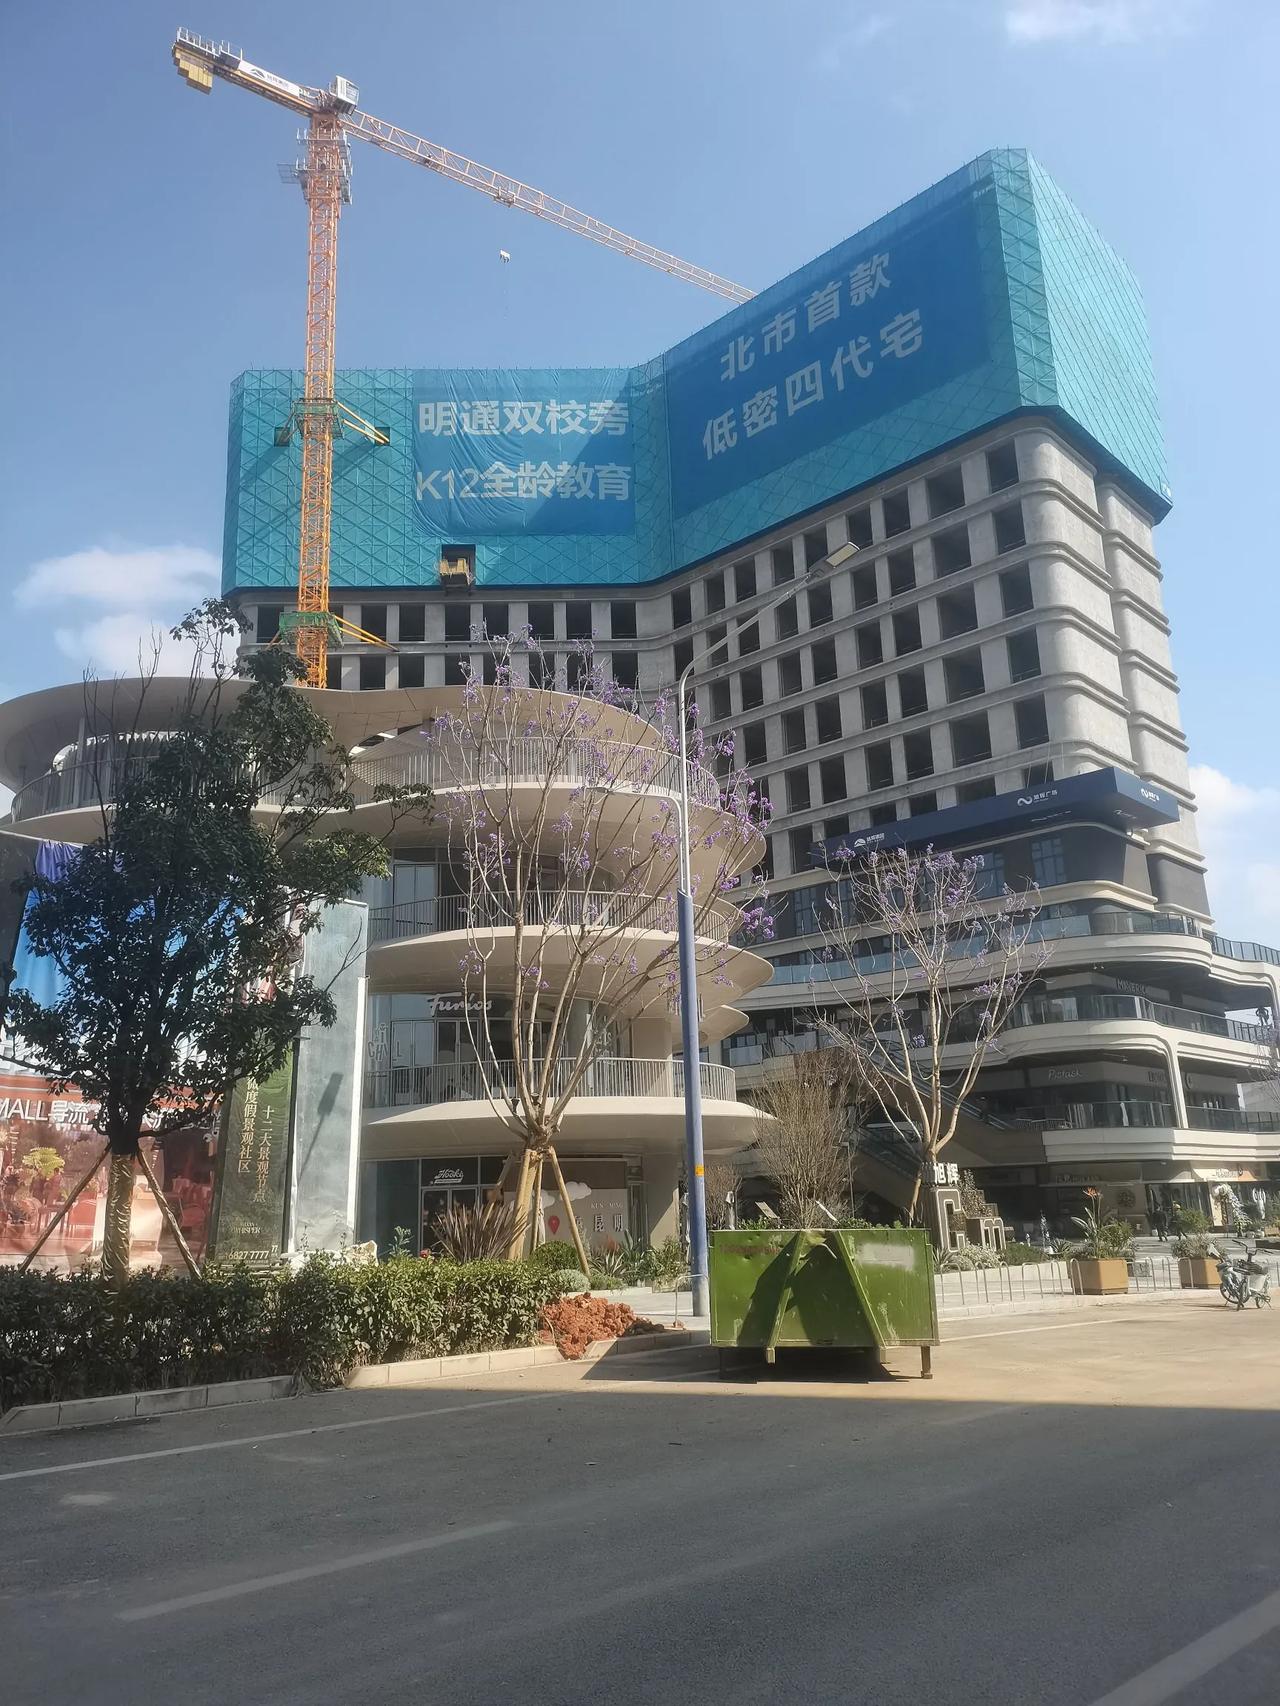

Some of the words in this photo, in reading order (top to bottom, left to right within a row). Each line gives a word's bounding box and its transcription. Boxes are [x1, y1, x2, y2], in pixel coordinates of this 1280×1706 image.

[720, 252, 892, 382] 北市首款
[418, 399, 629, 436] 明通双校旁
[702, 308, 923, 461] 低密四代宅
[415, 460, 632, 501] K12全龄教育
[253, 1105, 275, 1203] 十二大景观节点
[934, 1162, 959, 1185] 旭辉
